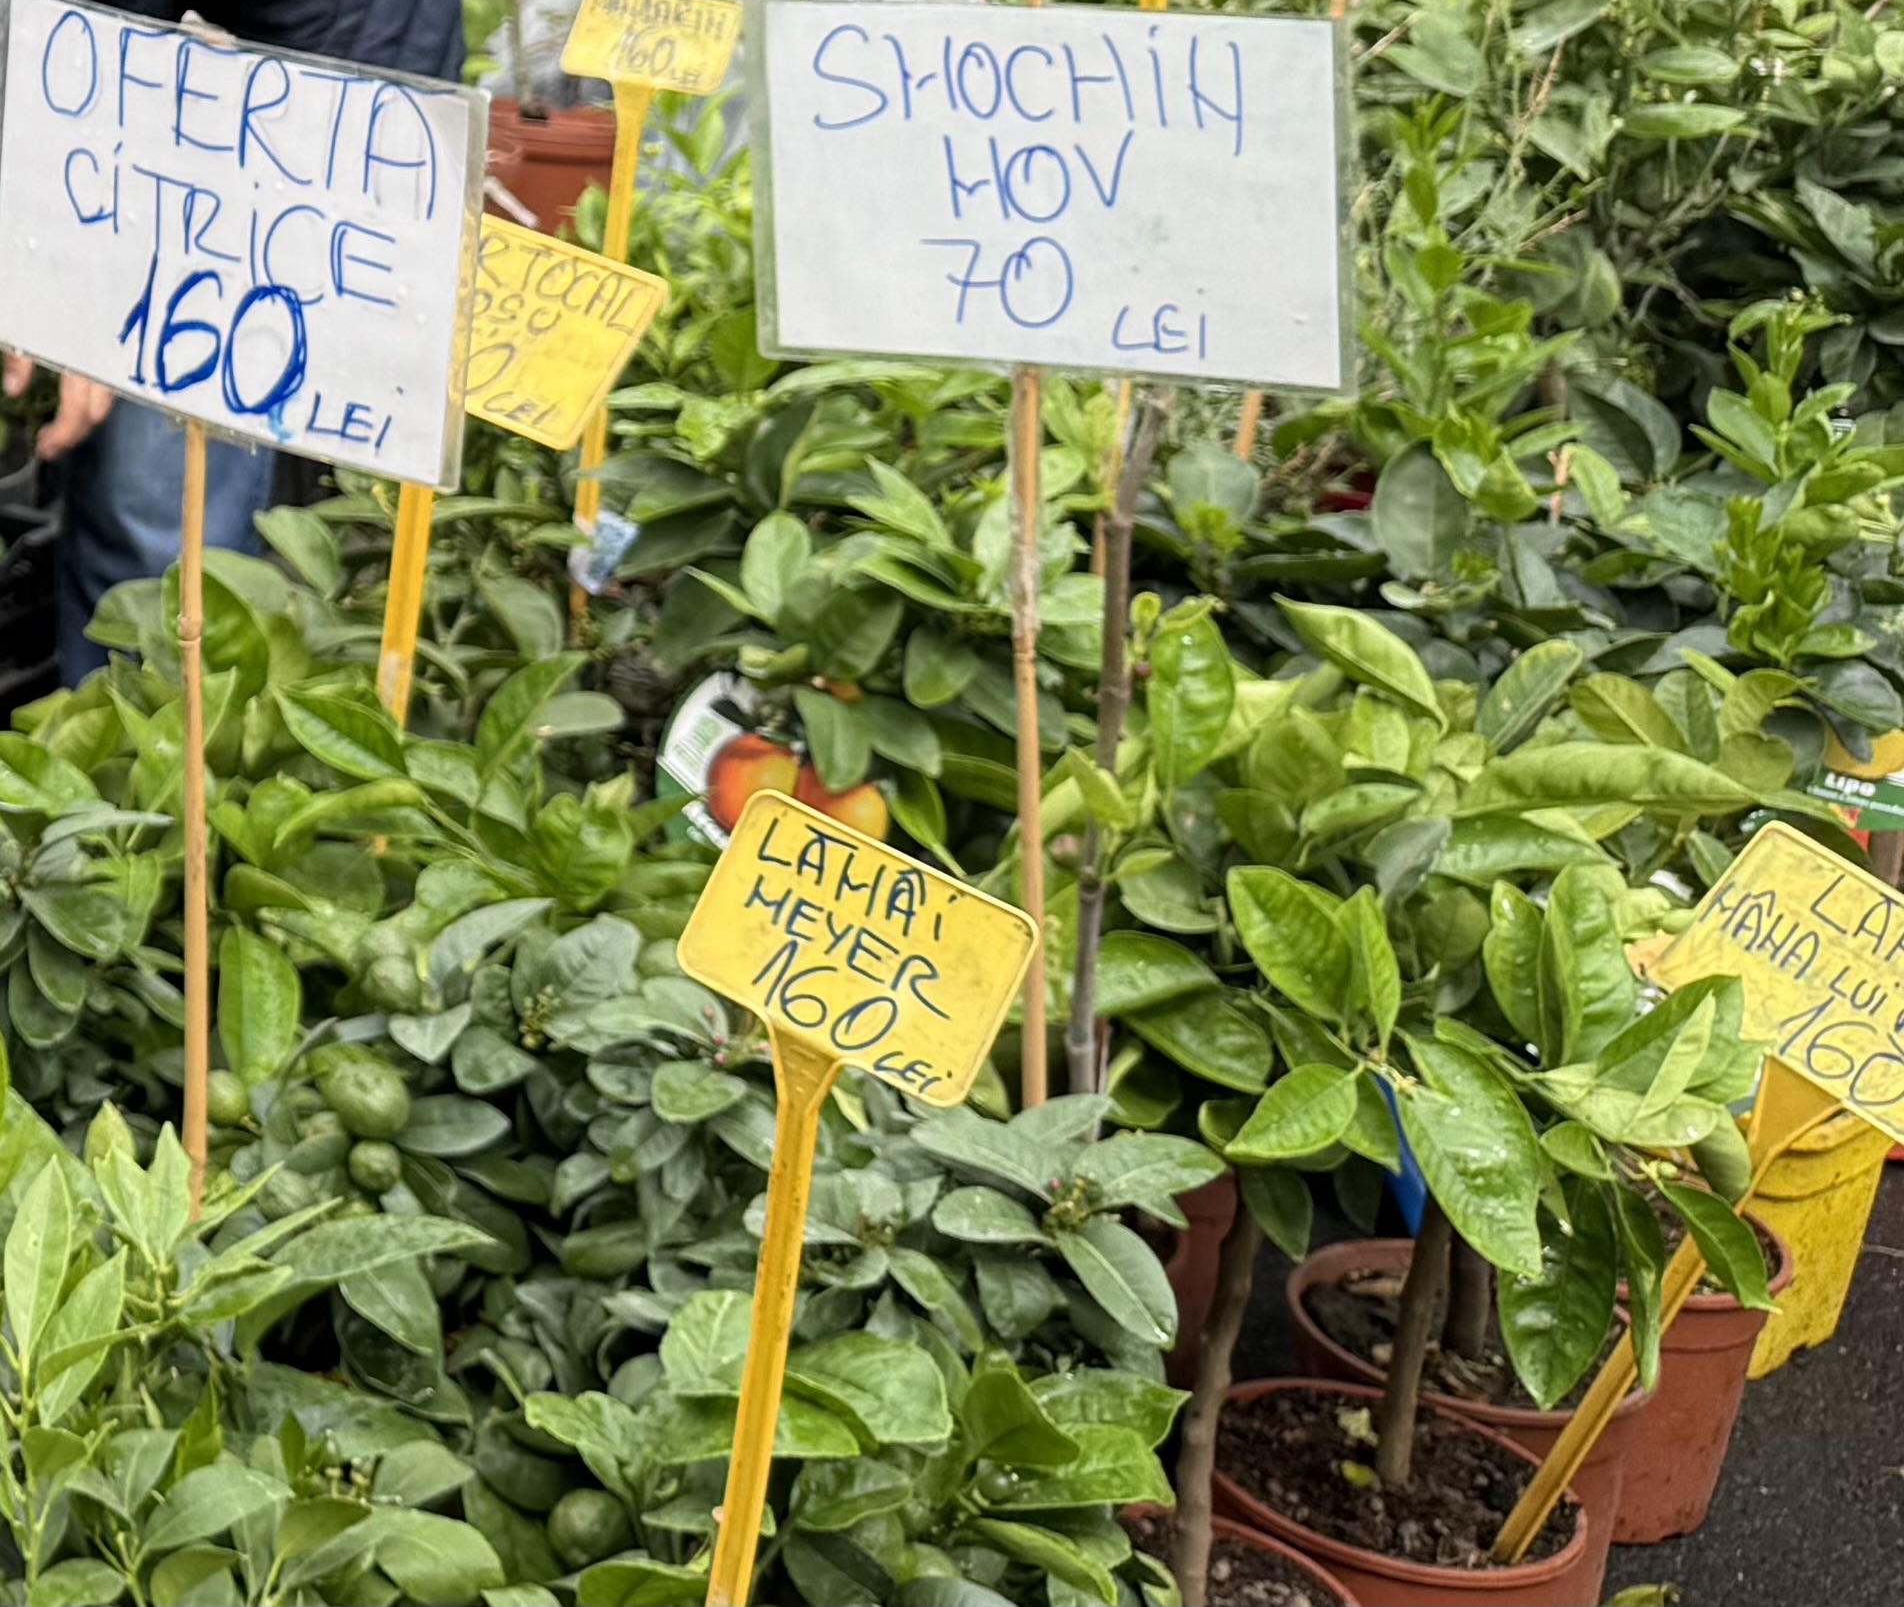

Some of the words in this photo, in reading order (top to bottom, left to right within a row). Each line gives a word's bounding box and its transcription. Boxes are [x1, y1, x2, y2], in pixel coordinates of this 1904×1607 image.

[611, 24, 677, 77] 160
[65, 141, 399, 306] CITRICE
[118, 254, 307, 414] 160
[304, 385, 404, 455] LEI
[918, 235, 1074, 329] 70
[1112, 287, 1207, 360] LEI
[743, 874, 951, 1021] MEYER
[751, 939, 899, 1051] 160
[872, 1049, 954, 1094] LEI
[1829, 965, 1901, 1018] LUI
